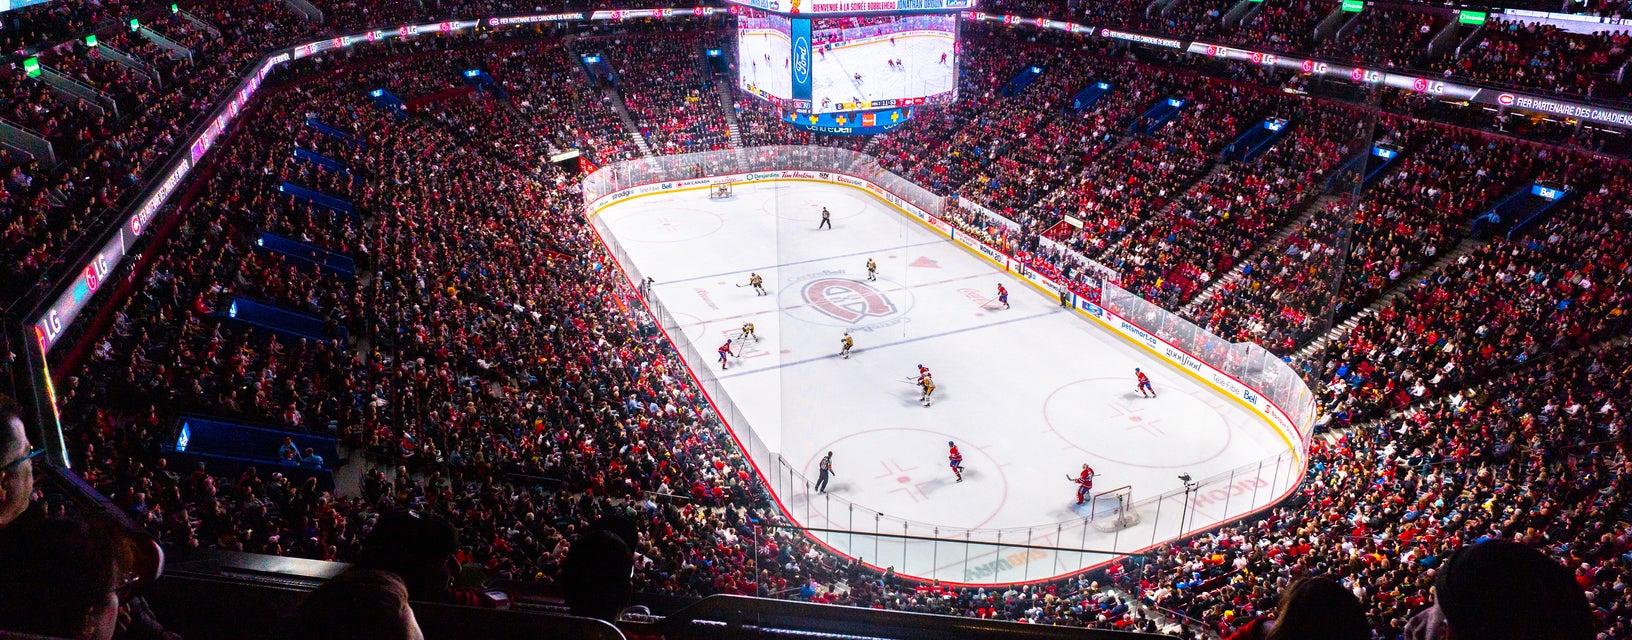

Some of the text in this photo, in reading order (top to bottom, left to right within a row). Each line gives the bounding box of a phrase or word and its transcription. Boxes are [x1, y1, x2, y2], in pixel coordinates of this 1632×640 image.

[813, 4, 838, 12] BIENVENUE
[844, 3, 849, 11] LA
[851, 2, 866, 10] SOIRÉE
[868, 2, 896, 10] BOBBLEHEAD
[796, 46, 807, 74] Ford
[1262, 54, 1274, 64] LG
[1314, 62, 1326, 73] LG
[1364, 70, 1378, 82] LG
[1428, 80, 1444, 93] LG
[1517, 98, 1532, 108] FIER
[1533, 100, 1575, 116] PARTENAIRE
[1576, 107, 1590, 118] DES
[1540, 188, 1555, 198] Bell
[94, 254, 108, 281] LG
[44, 309, 61, 342] LG
[1121, 322, 1157, 345] petsmart.ca
[1244, 390, 1257, 405] Bell
[1190, 477, 1269, 507] RICOH
